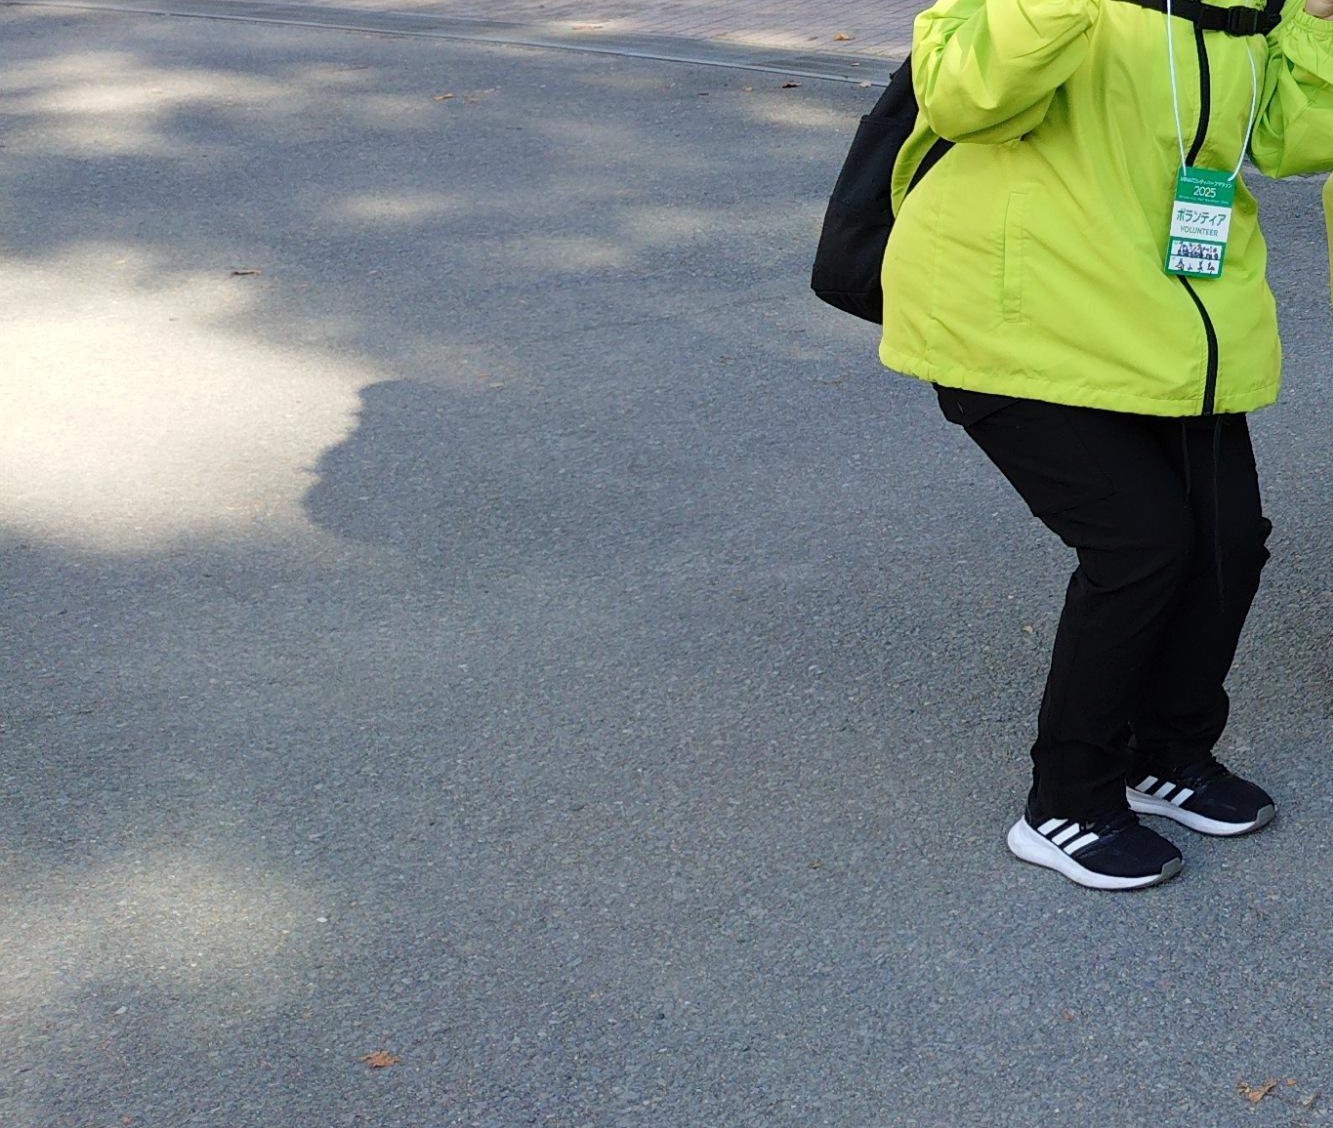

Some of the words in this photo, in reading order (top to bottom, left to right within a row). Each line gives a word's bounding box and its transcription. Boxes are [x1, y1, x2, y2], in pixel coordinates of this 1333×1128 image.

[1193, 185, 1217, 198] 2025
[1176, 208, 1226, 227] ボランティア
[1180, 225, 1219, 237] VOLUNTEER
